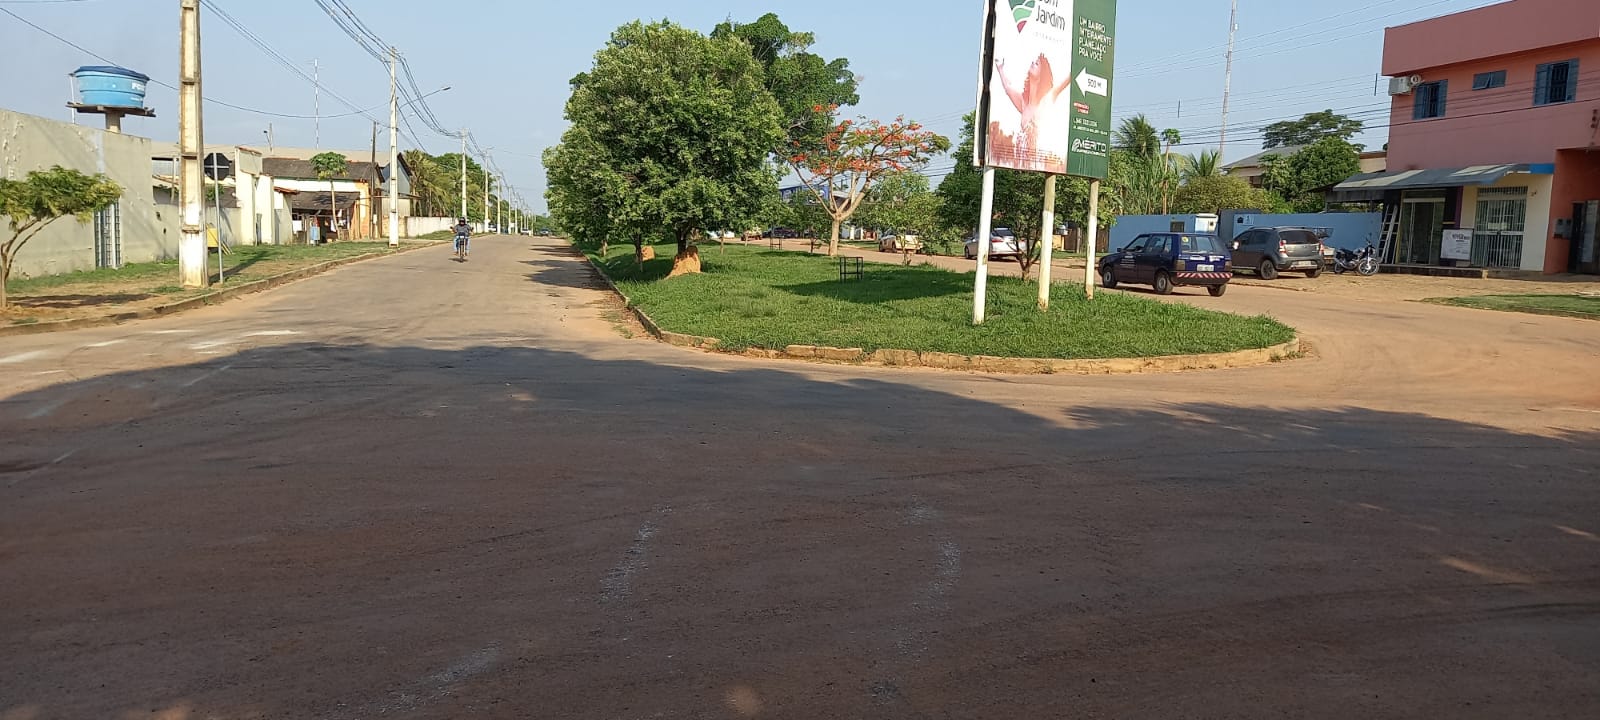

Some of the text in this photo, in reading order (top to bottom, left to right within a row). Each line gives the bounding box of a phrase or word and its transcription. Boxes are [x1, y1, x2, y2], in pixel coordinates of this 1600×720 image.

[1036, 5, 1065, 31] Jardim
[1088, 19, 1105, 33] BAIRRO
[1081, 137, 1106, 152] MÉRITO
